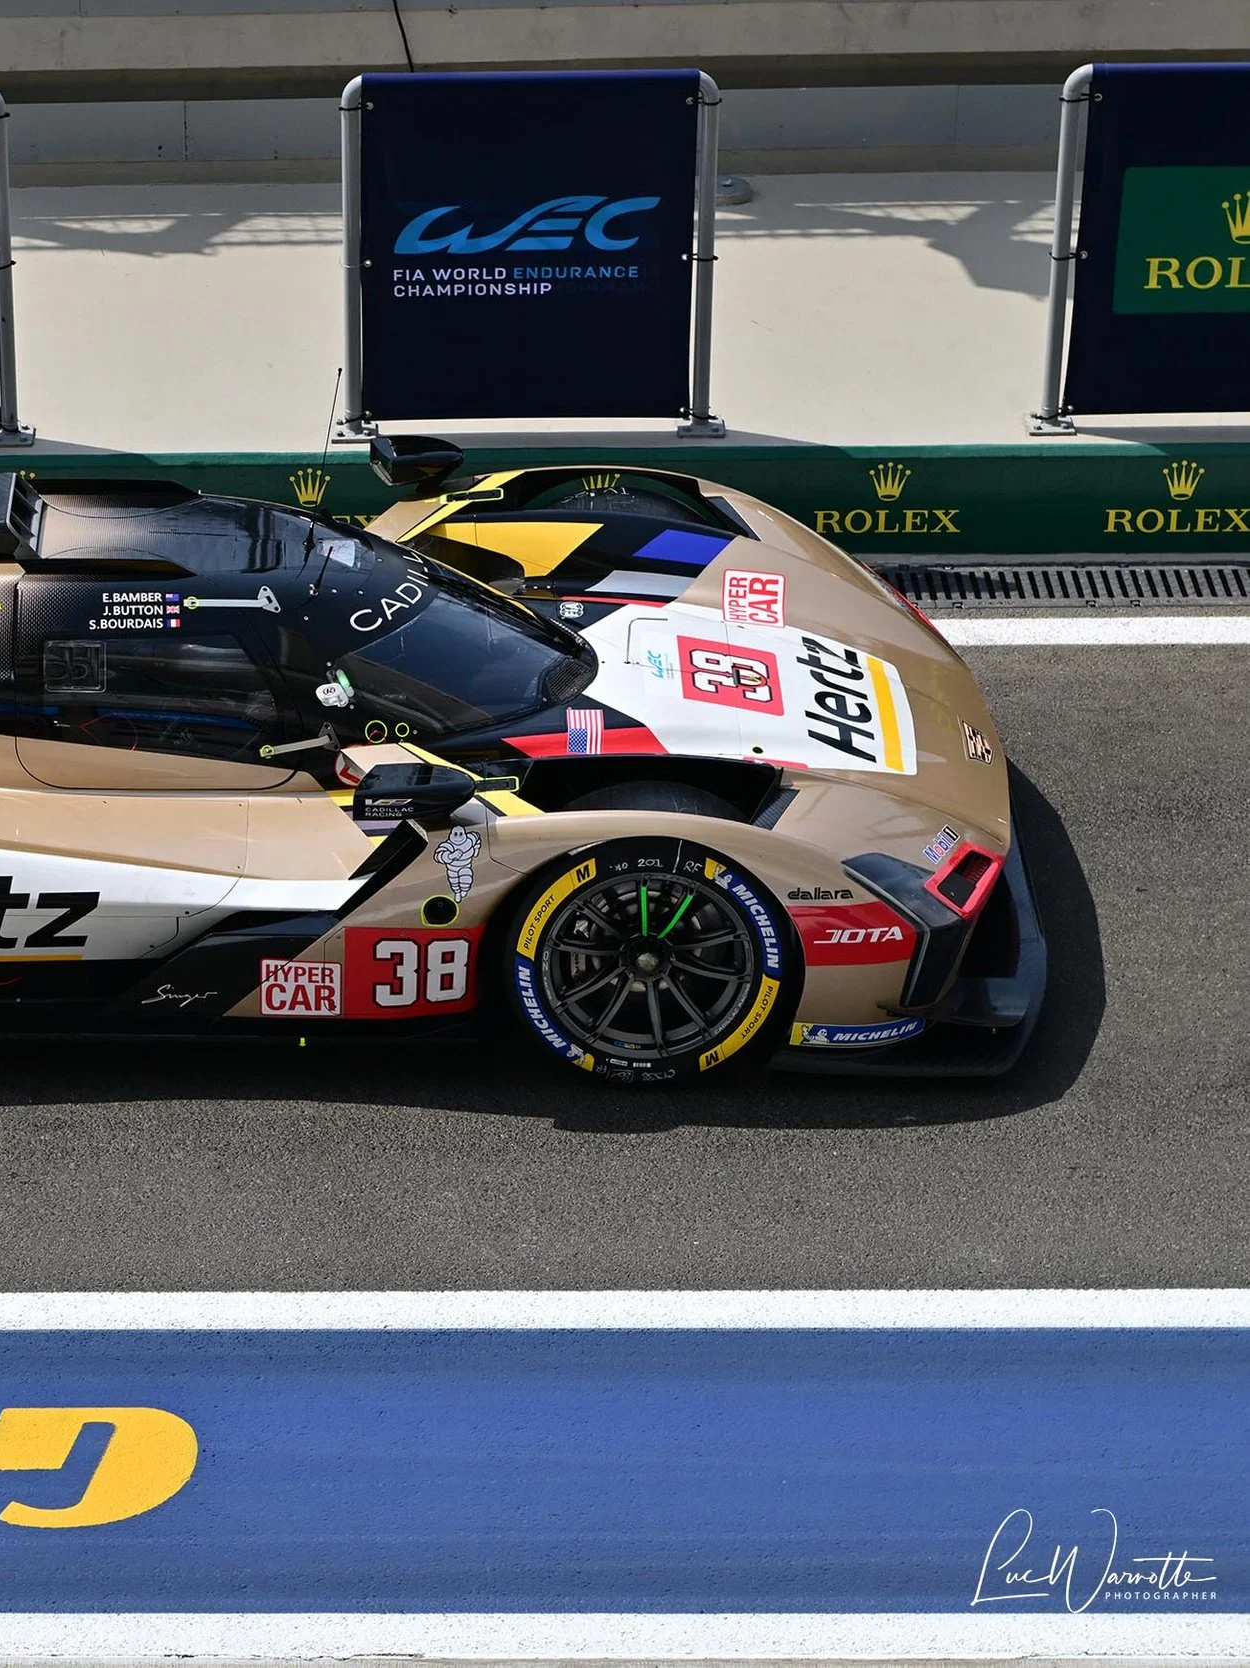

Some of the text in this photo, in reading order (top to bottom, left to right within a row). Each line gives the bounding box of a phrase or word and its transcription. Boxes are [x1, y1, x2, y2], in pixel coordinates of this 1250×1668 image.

[394, 196, 661, 254] WEC
[393, 266, 639, 282] FIA WORLD ENDURANCE
[1144, 256, 1250, 289] ROL
[393, 283, 552, 297] CHAMPIONSHIP
[814, 509, 960, 533] ROLEX
[1104, 509, 1250, 533] ROLEX
[102, 593, 162, 603] E.BAMBER
[729, 576, 748, 622] HYPER
[750, 577, 779, 624] CAR
[89, 618, 163, 630] S.BOURDAIS
[796, 636, 877, 763] Hertz
[923, 829, 951, 865] Mobil
[576, 864, 591, 883] M
[683, 860, 703, 873] RF
[787, 887, 854, 900] dallara
[523, 894, 556, 950] PILOT SPORT
[732, 884, 780, 969] MICHELIN
[814, 926, 904, 944] JOTA
[265, 964, 335, 983] HYPER
[373, 937, 472, 1007] 38
[265, 983, 337, 1011] CAR
[518, 965, 567, 1049] MICHELIN
[741, 985, 774, 1040] PILOT SPORT
[832, 1020, 918, 1041] MICHELIN
[705, 1050, 720, 1067] M
